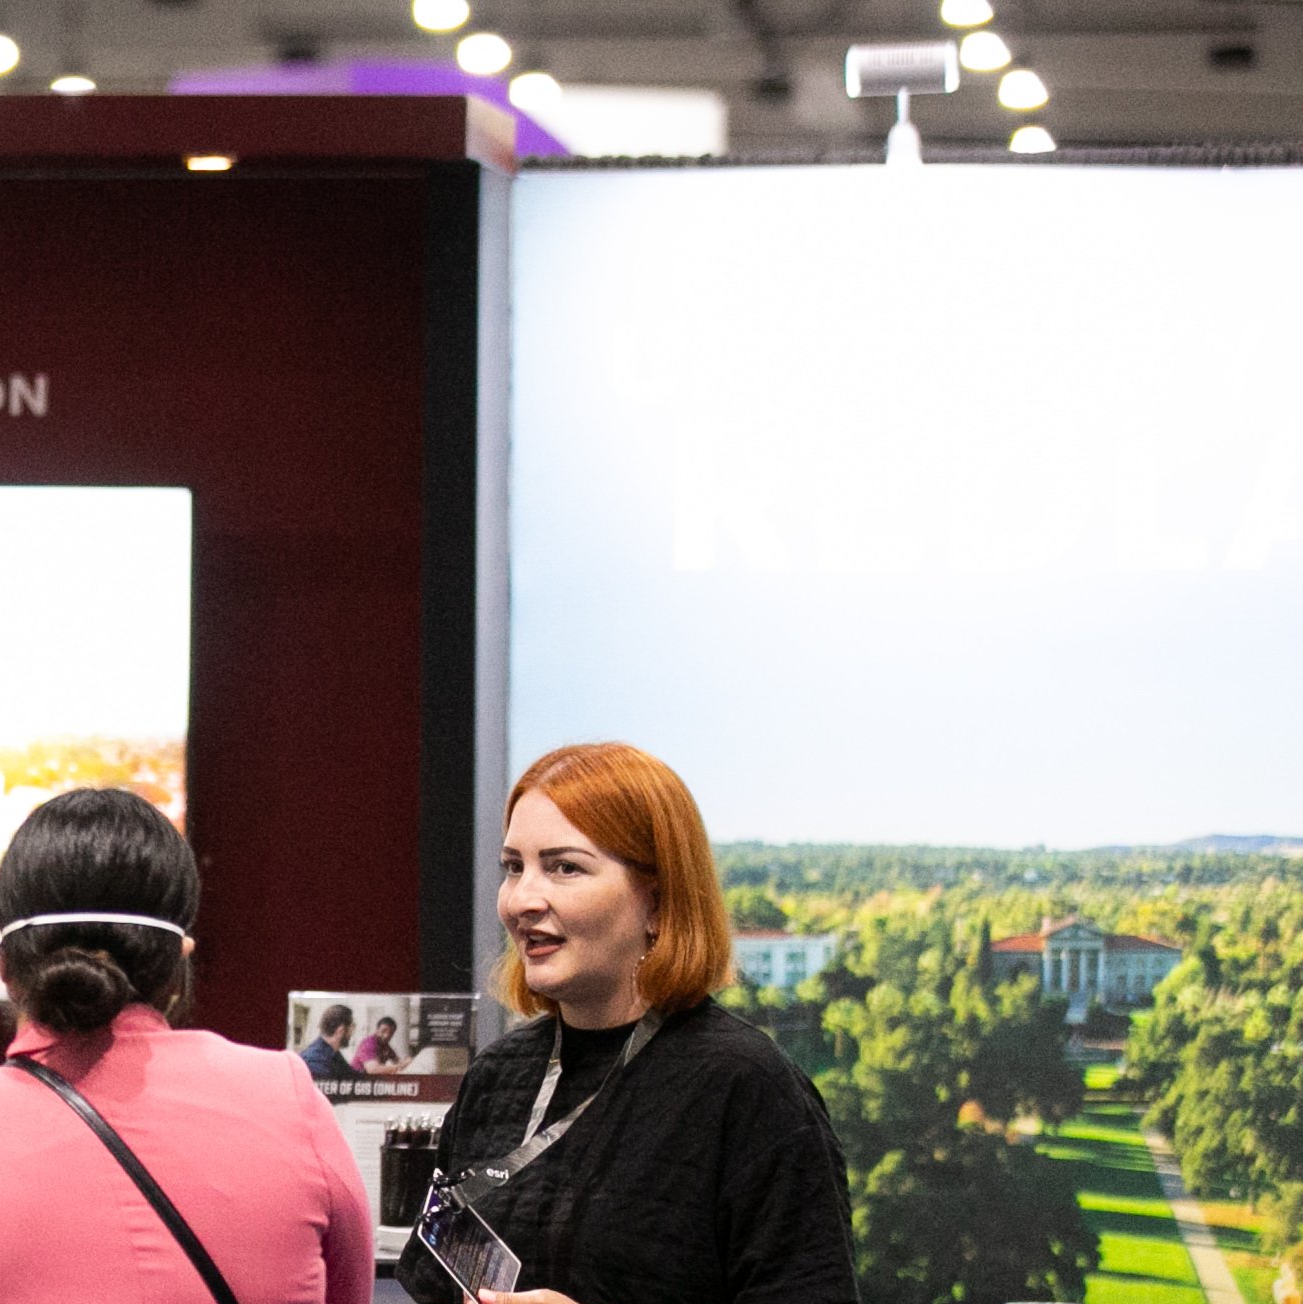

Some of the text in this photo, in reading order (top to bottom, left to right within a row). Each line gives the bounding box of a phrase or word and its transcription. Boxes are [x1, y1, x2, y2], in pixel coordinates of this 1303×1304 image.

[339, 1081, 353, 1095] OF
[354, 1081, 372, 1096] GIS
[373, 1081, 419, 1097] (ONLINE)
[486, 1167, 510, 1180] esri
